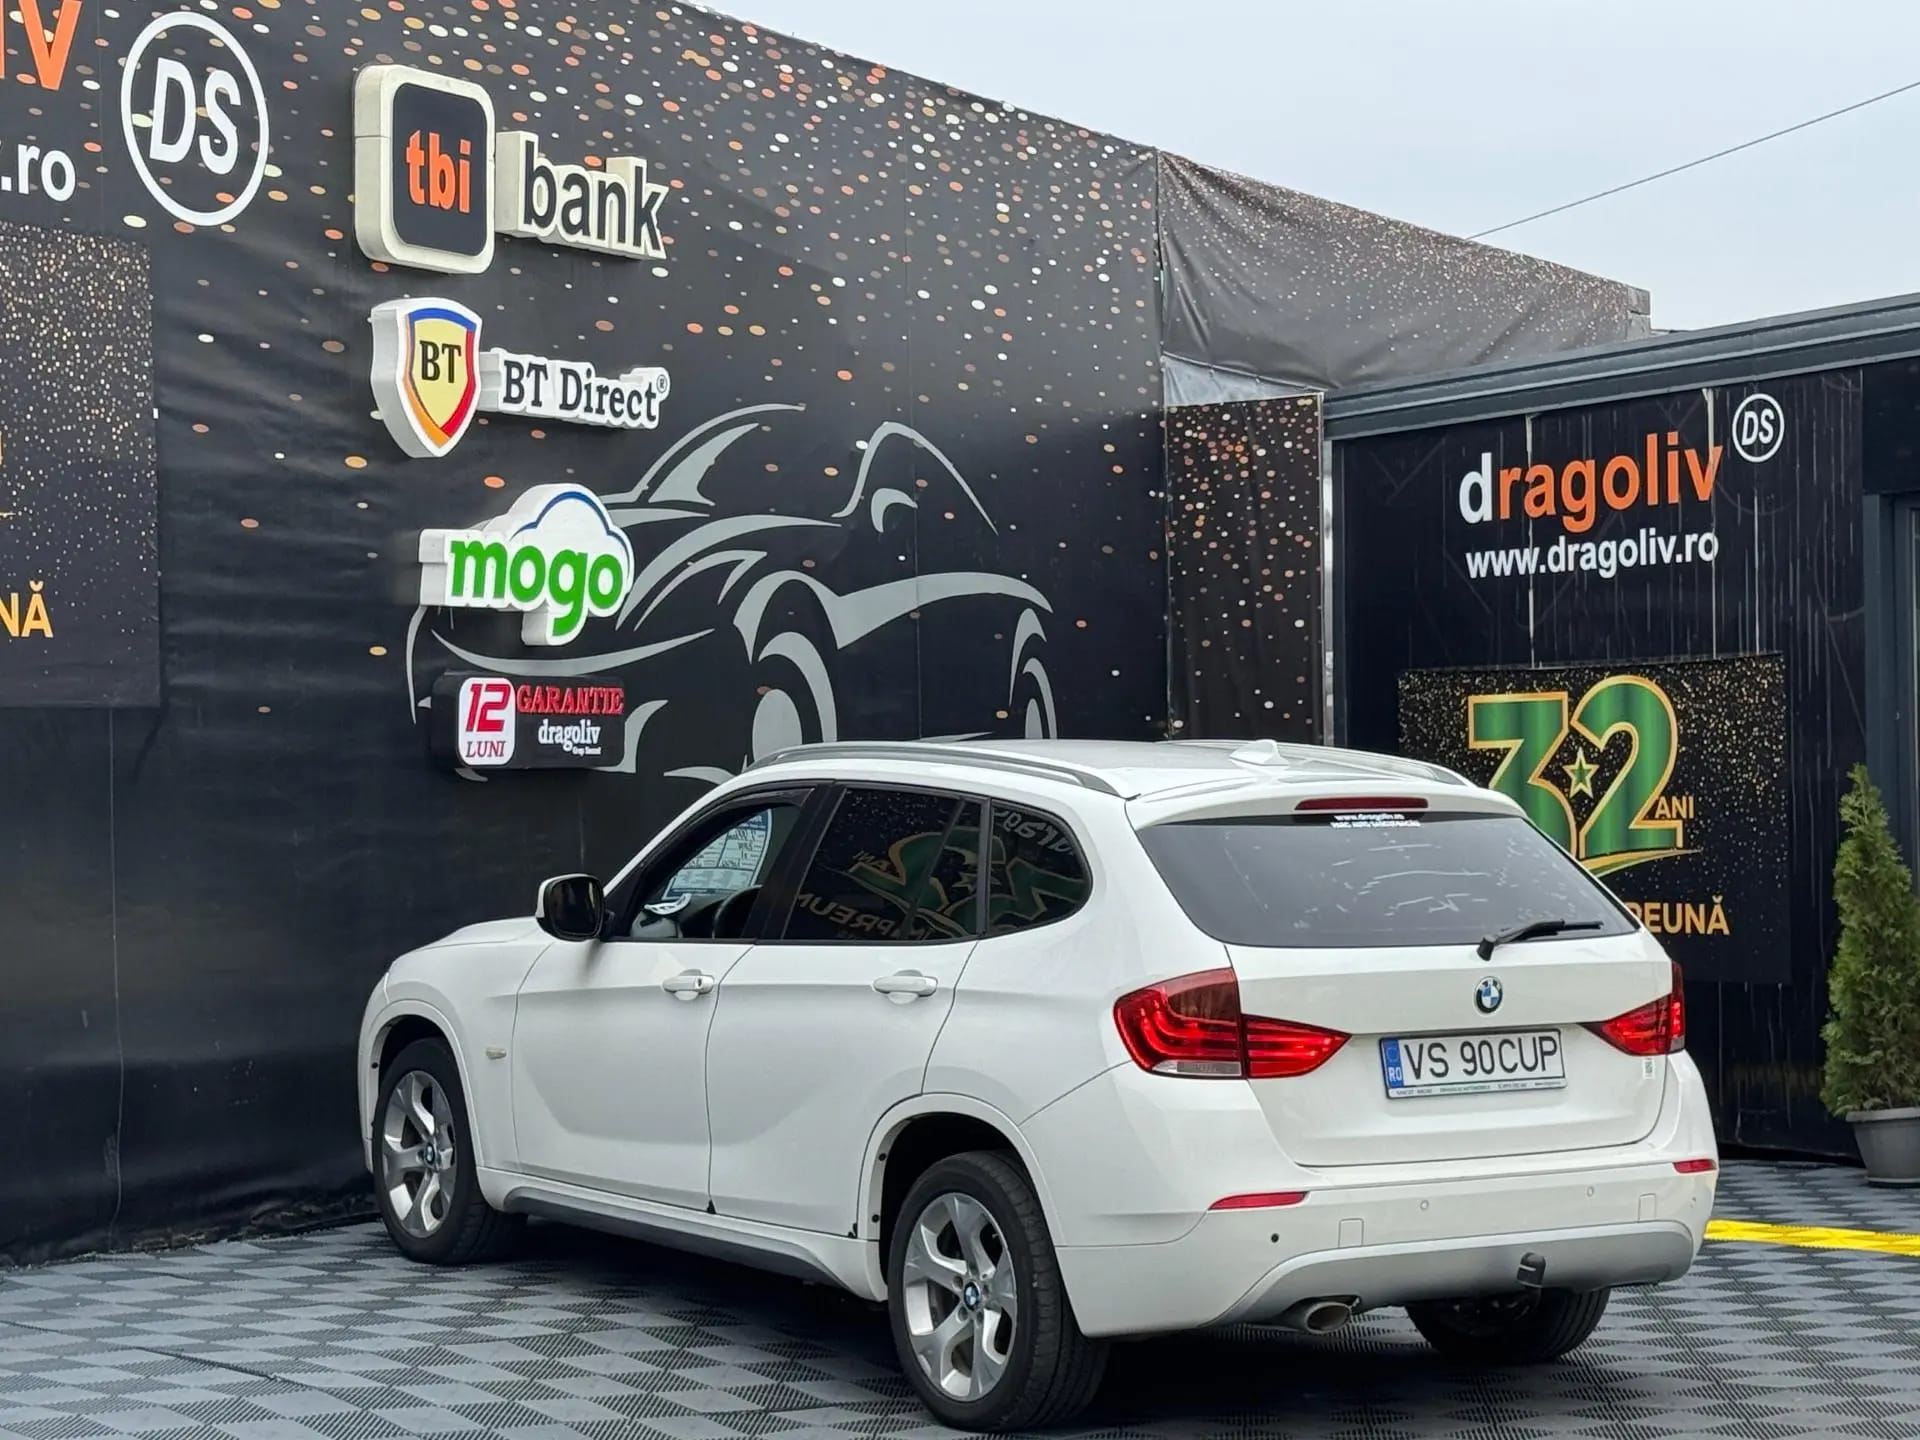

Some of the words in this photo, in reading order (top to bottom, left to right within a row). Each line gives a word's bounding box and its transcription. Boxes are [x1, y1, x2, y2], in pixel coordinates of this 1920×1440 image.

[150, 57, 241, 175] DS
[406, 130, 471, 213] tbi
[524, 140, 662, 251] bank
[419, 340, 461, 384] BT
[503, 360, 548, 407] BT
[1741, 408, 1775, 446] DS
[1459, 431, 1723, 533] dragoliv
[1466, 527, 1719, 579] www.dragoliv.ro
[450, 540, 623, 636] mogo
[465, 683, 511, 732] 12
[516, 686, 624, 714] GARANTIE
[466, 741, 506, 758] LUNI
[538, 719, 602, 752] dragoliv
[1468, 675, 1683, 858] 32
[1655, 796, 1695, 819] ANI
[1389, 1067, 1402, 1082] RO
[1405, 1043, 1449, 1080] VS
